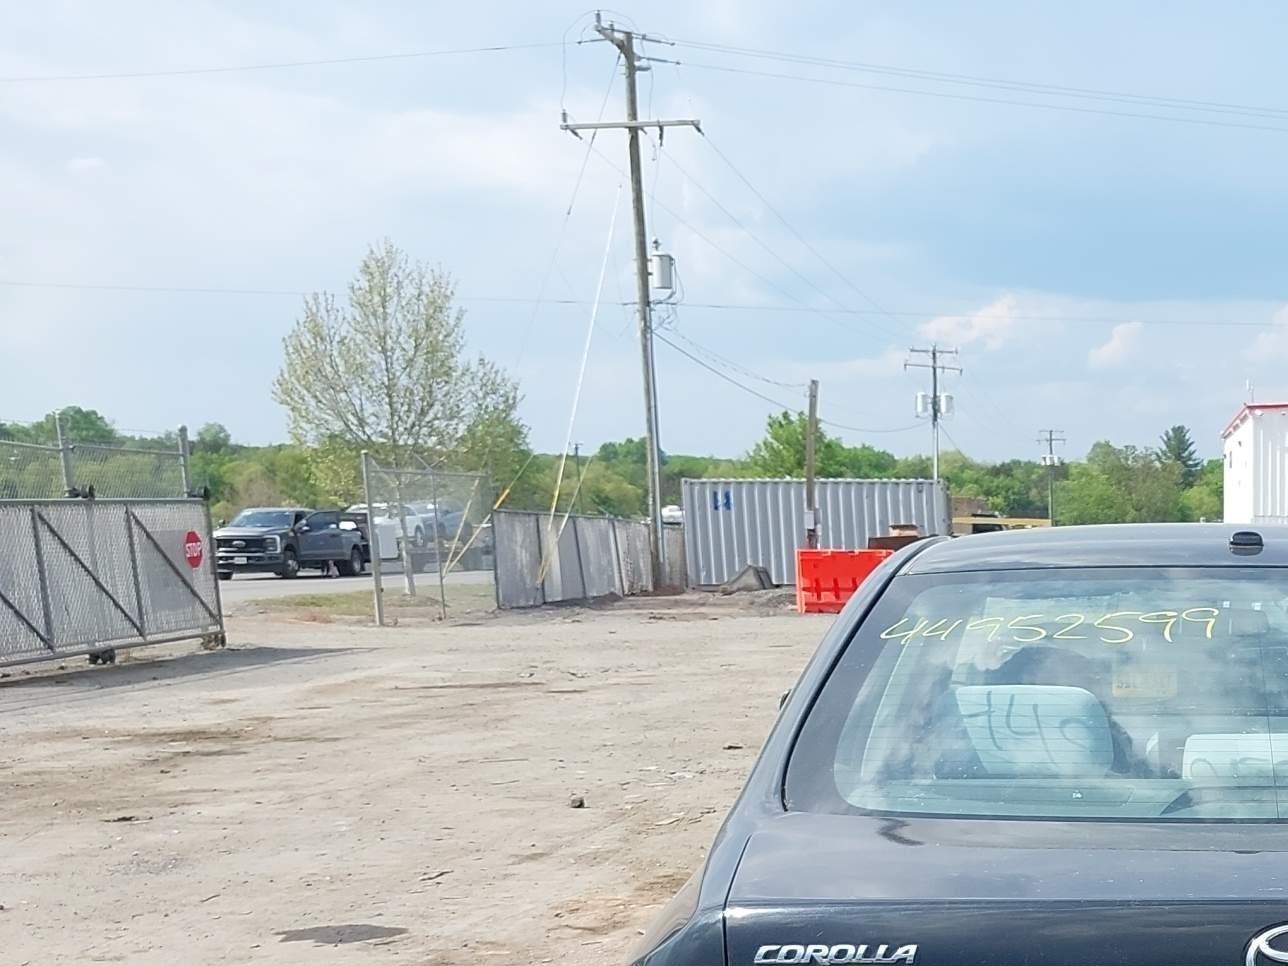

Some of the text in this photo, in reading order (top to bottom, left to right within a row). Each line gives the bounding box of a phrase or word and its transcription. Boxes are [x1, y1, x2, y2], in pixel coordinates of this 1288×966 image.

[186, 542, 202, 558] STOP
[879, 607, 1220, 644] 44952599
[753, 944, 918, 966] COROLLA
